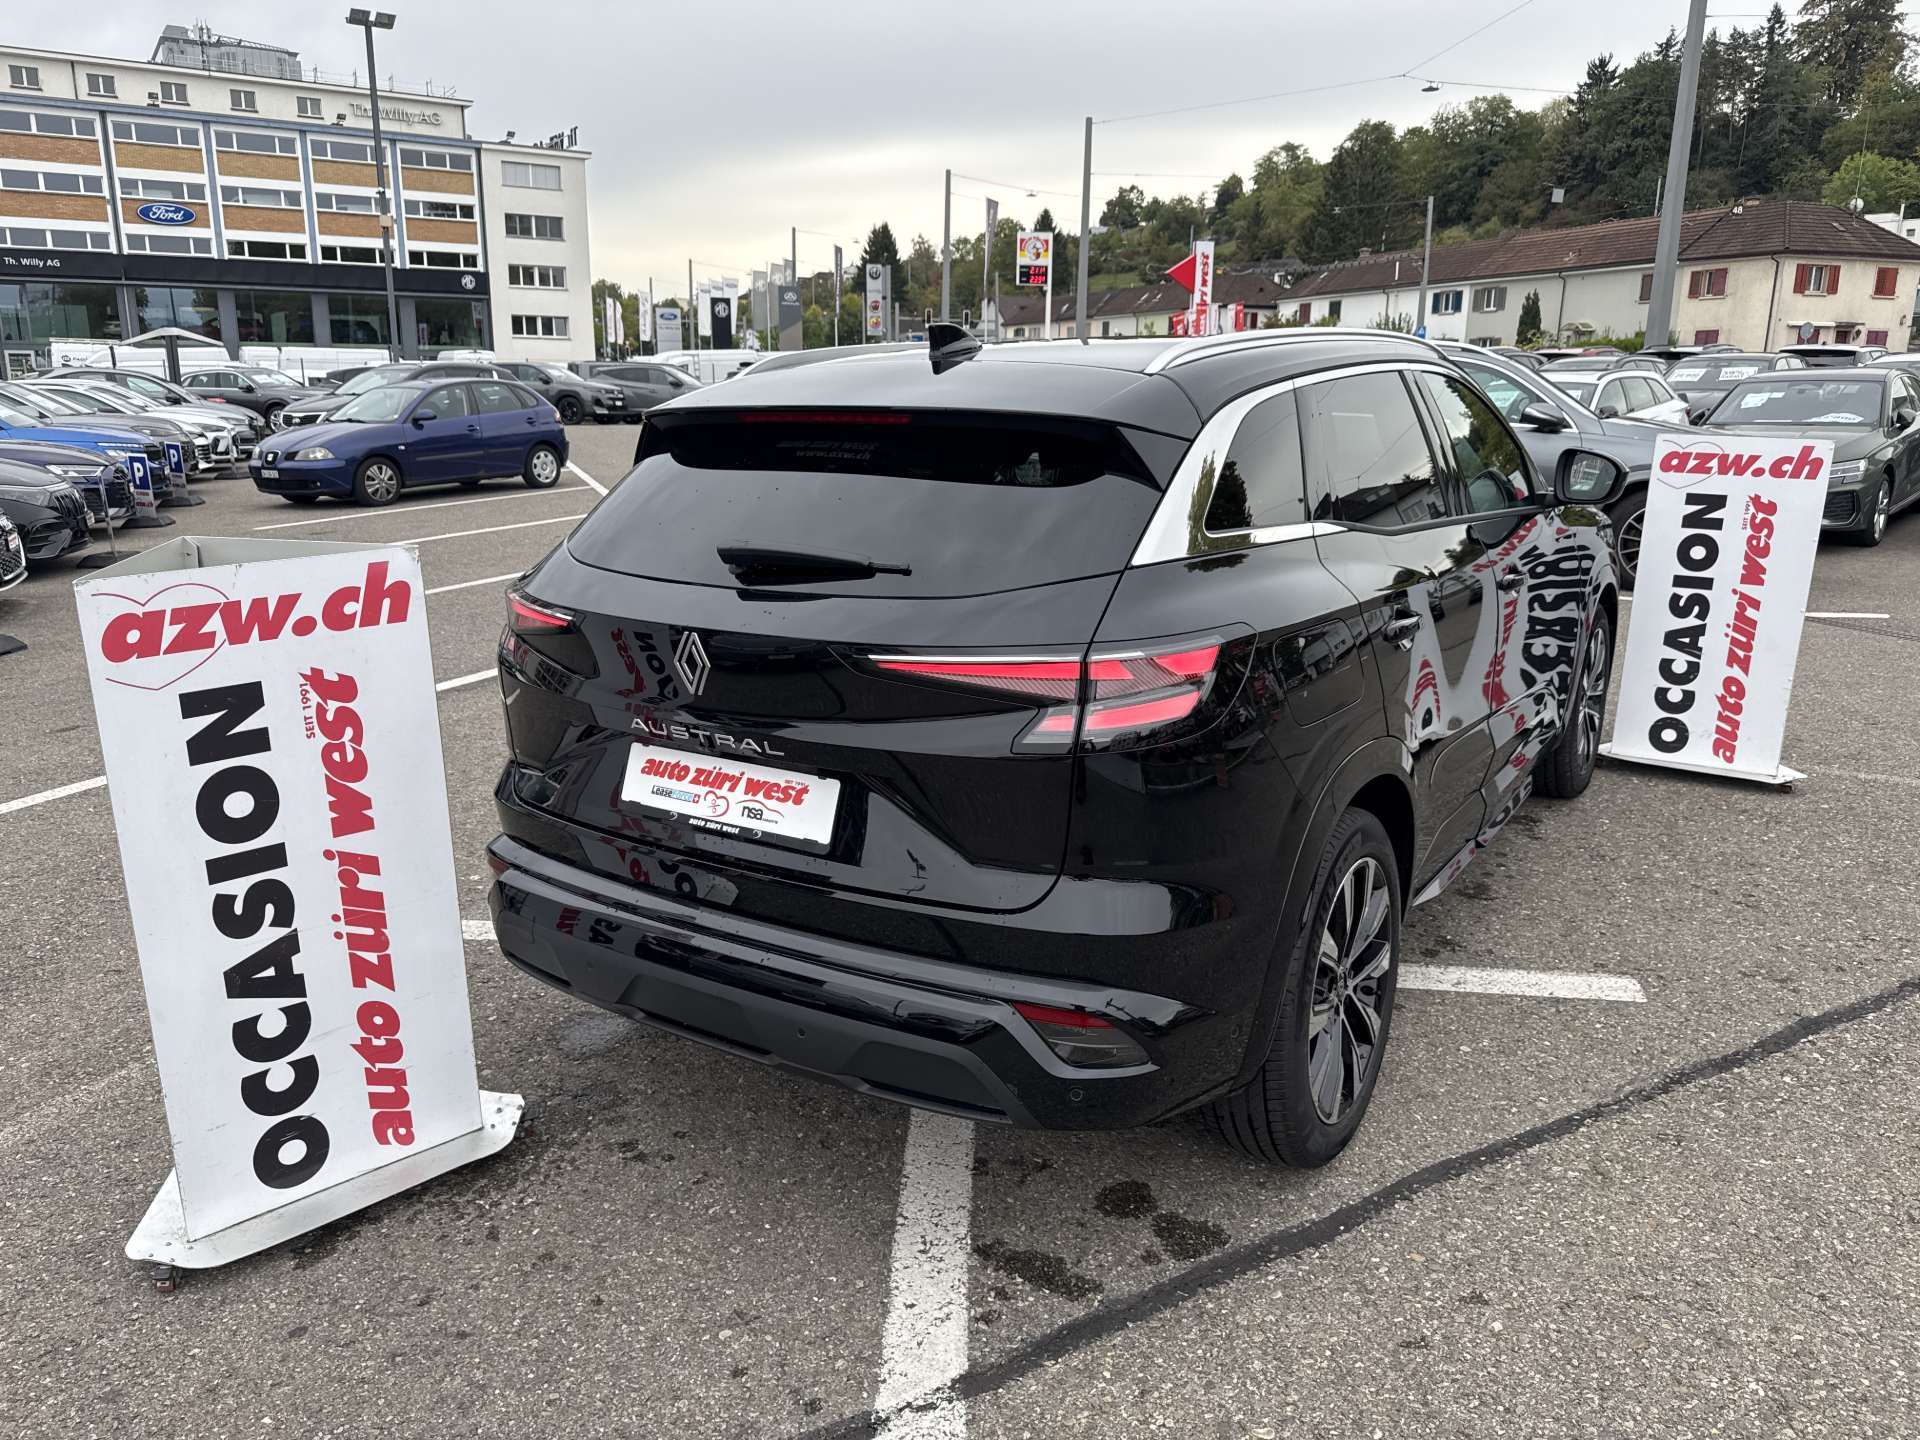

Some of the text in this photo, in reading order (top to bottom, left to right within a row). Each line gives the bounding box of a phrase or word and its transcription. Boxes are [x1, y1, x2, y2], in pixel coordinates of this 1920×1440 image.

[378, 105, 415, 125] Willy
[418, 111, 441, 125] AG
[149, 205, 184, 221] Ford
[1732, 206, 1743, 214] 48
[3, 257, 61, 268] Th. Willy AG
[714, 302, 729, 318] MG
[133, 462, 144, 485] P
[170, 449, 178, 469] P
[1659, 445, 1824, 480] azw.ch
[100, 561, 411, 663] azw.ch
[1648, 492, 1728, 753] OCCASION
[1712, 493, 1778, 764] auto züri west
[300, 682, 316, 739] SEIT 1991
[631, 718, 785, 756] AUSTRAL
[640, 757, 810, 806] auto züri west
[688, 818, 706, 827] auto
[722, 824, 740, 834] west
[741, 805, 764, 820] nsa
[298, 667, 415, 1146] auto züri west
[178, 680, 330, 1189] OCCASION
